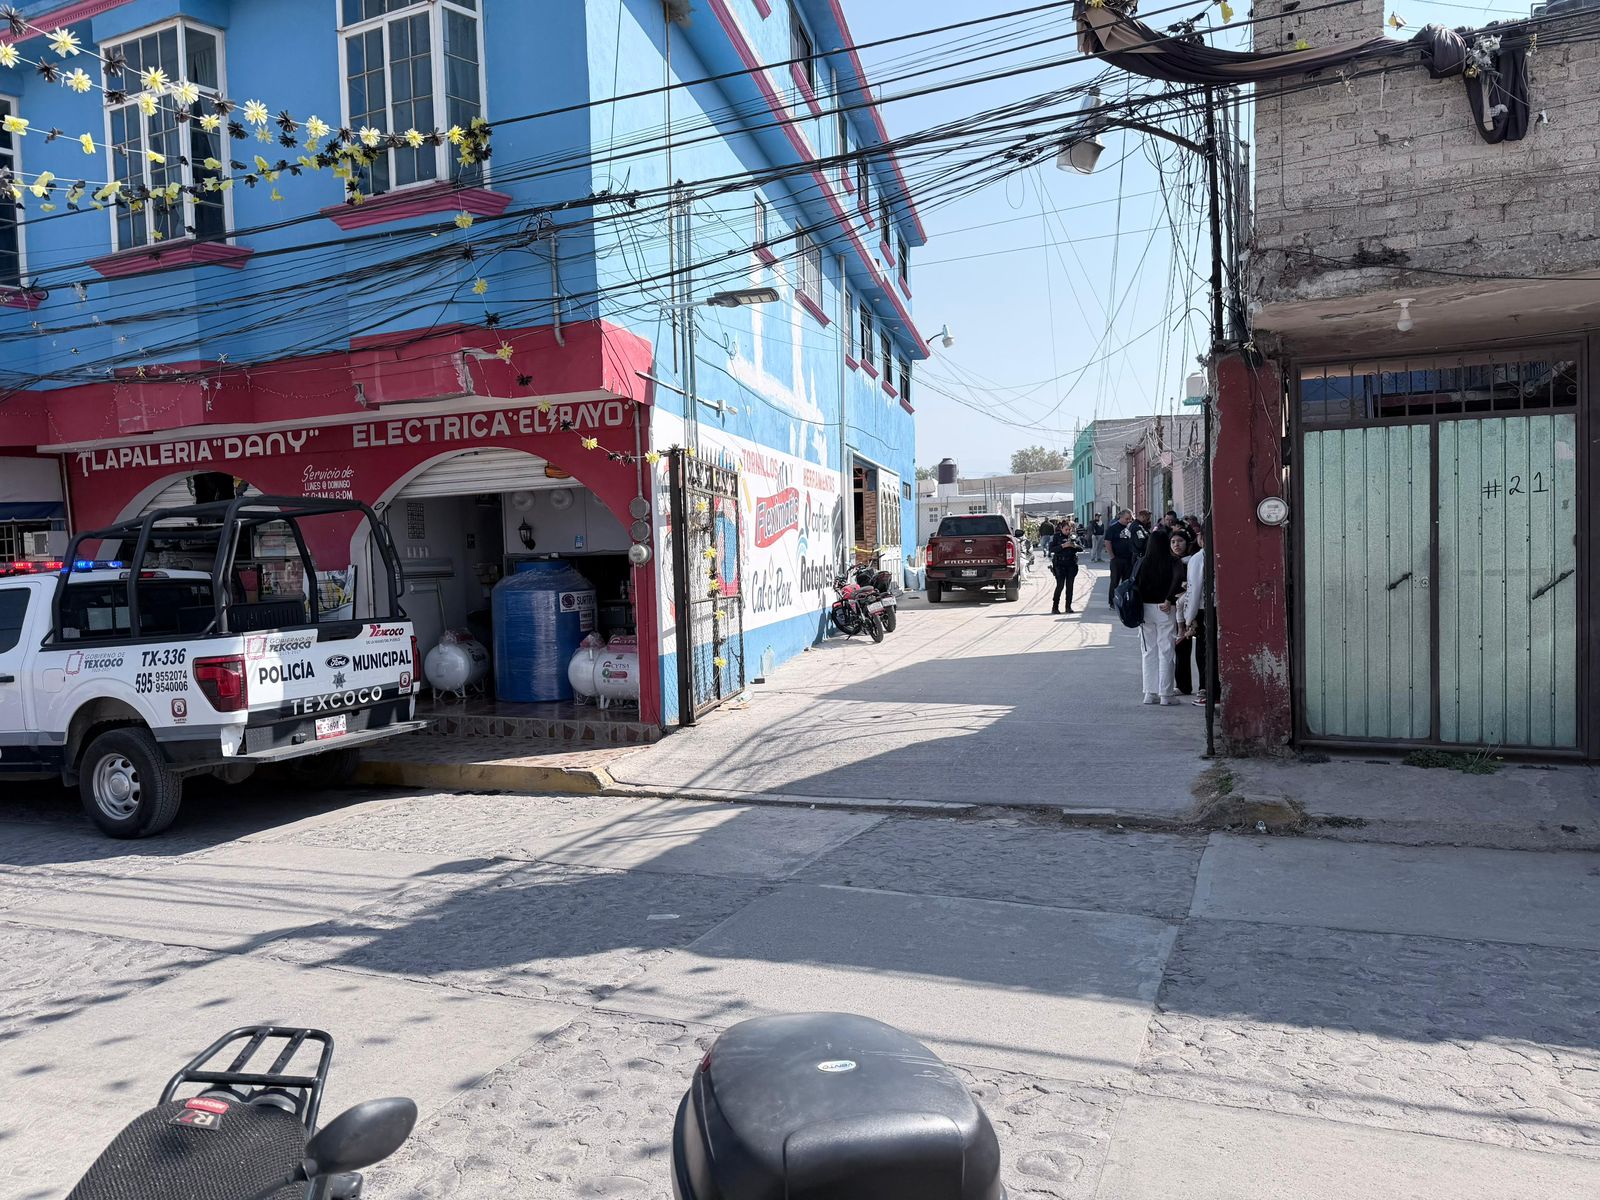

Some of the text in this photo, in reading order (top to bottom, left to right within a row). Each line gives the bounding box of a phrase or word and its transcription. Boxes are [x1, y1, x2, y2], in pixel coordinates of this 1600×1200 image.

[352, 412, 512, 448] ELECTRICA
[76, 440, 213, 477] TLAPALERIA
[301, 464, 341, 482] Servicio
[304, 481, 321, 491] LUNES
[327, 479, 351, 490] DOMINGO
[800, 555, 834, 598] Rotoplas
[269, 640, 312, 652] TEXCOCO
[84, 657, 124, 669] TEXCOCO
[85, 652, 116, 660] GOBIERNO
[141, 647, 187, 667] TX-336
[352, 649, 412, 672] MUNICIPAL
[155, 670, 187, 681] 9552074
[258, 659, 315, 685] POLICÍA
[155, 681, 188, 693] 9540006
[291, 686, 383, 715] TEXCOCO
